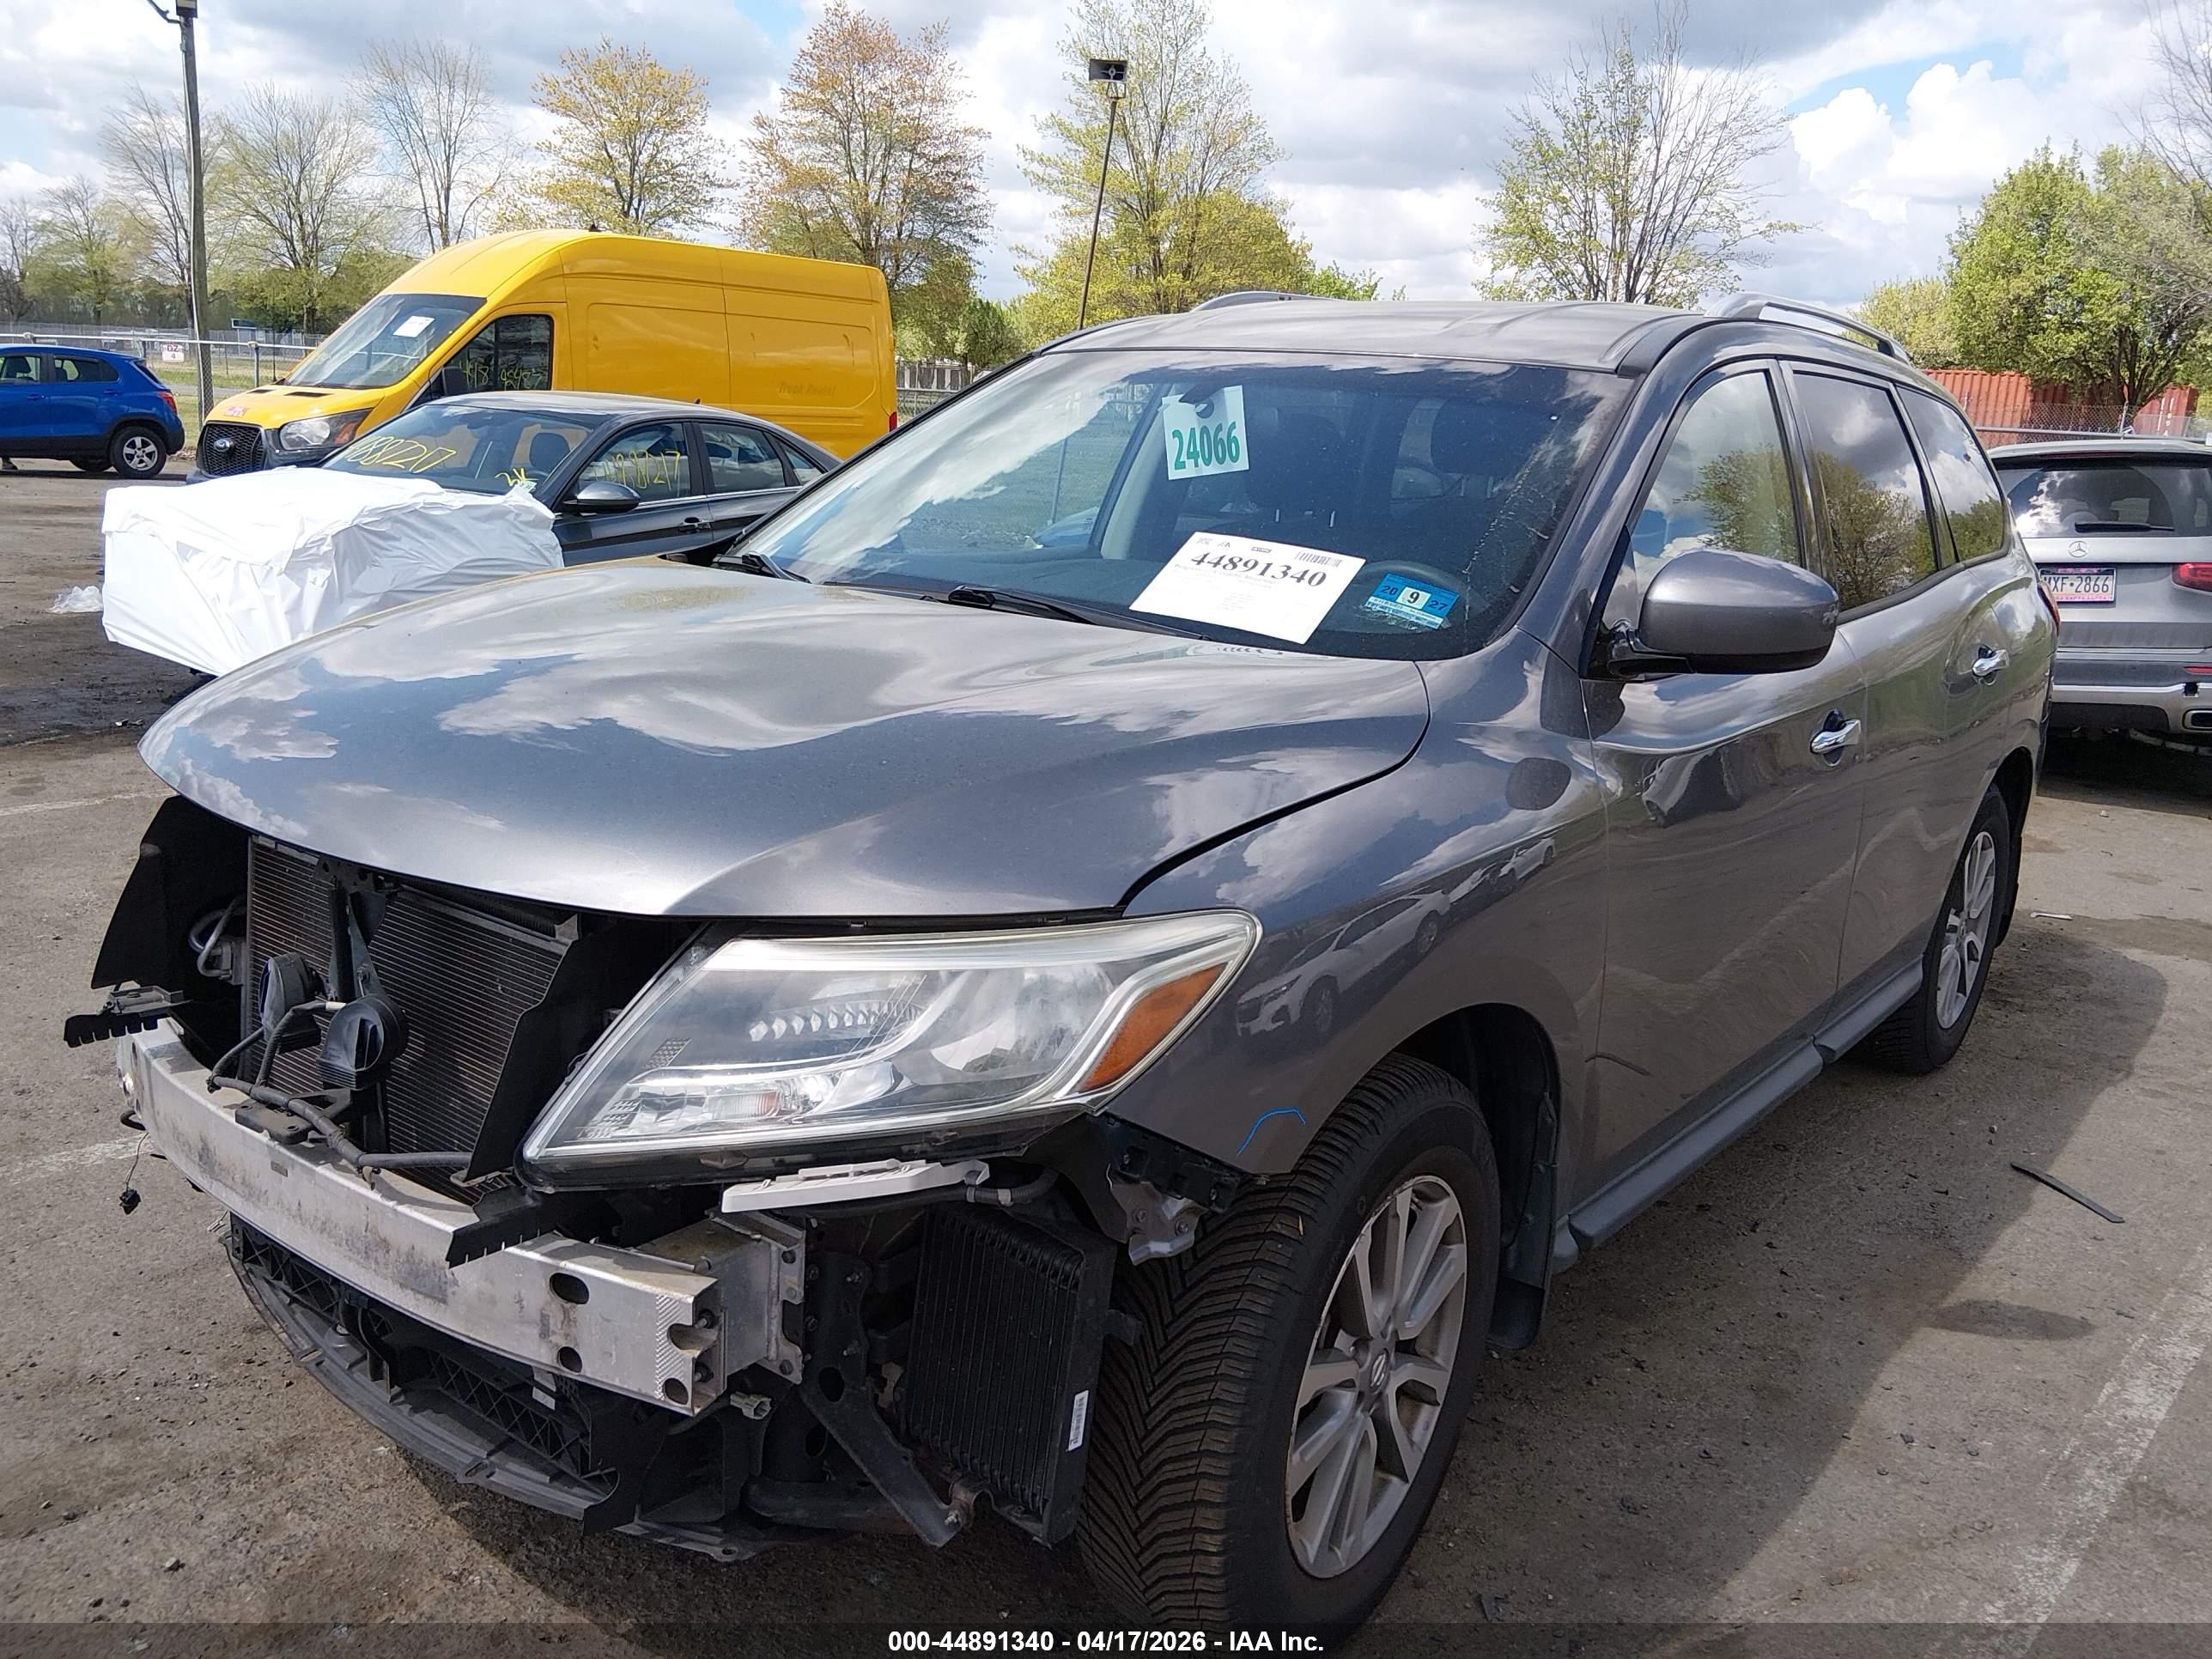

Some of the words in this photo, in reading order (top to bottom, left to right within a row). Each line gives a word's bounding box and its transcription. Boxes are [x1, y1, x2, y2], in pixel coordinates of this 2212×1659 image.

[1172, 421, 1240, 471] 24066
[1191, 551, 1327, 587] 44891340
[1381, 585, 1399, 596] 20
[1407, 591, 1420, 604] 9
[1428, 600, 1449, 611] 27
